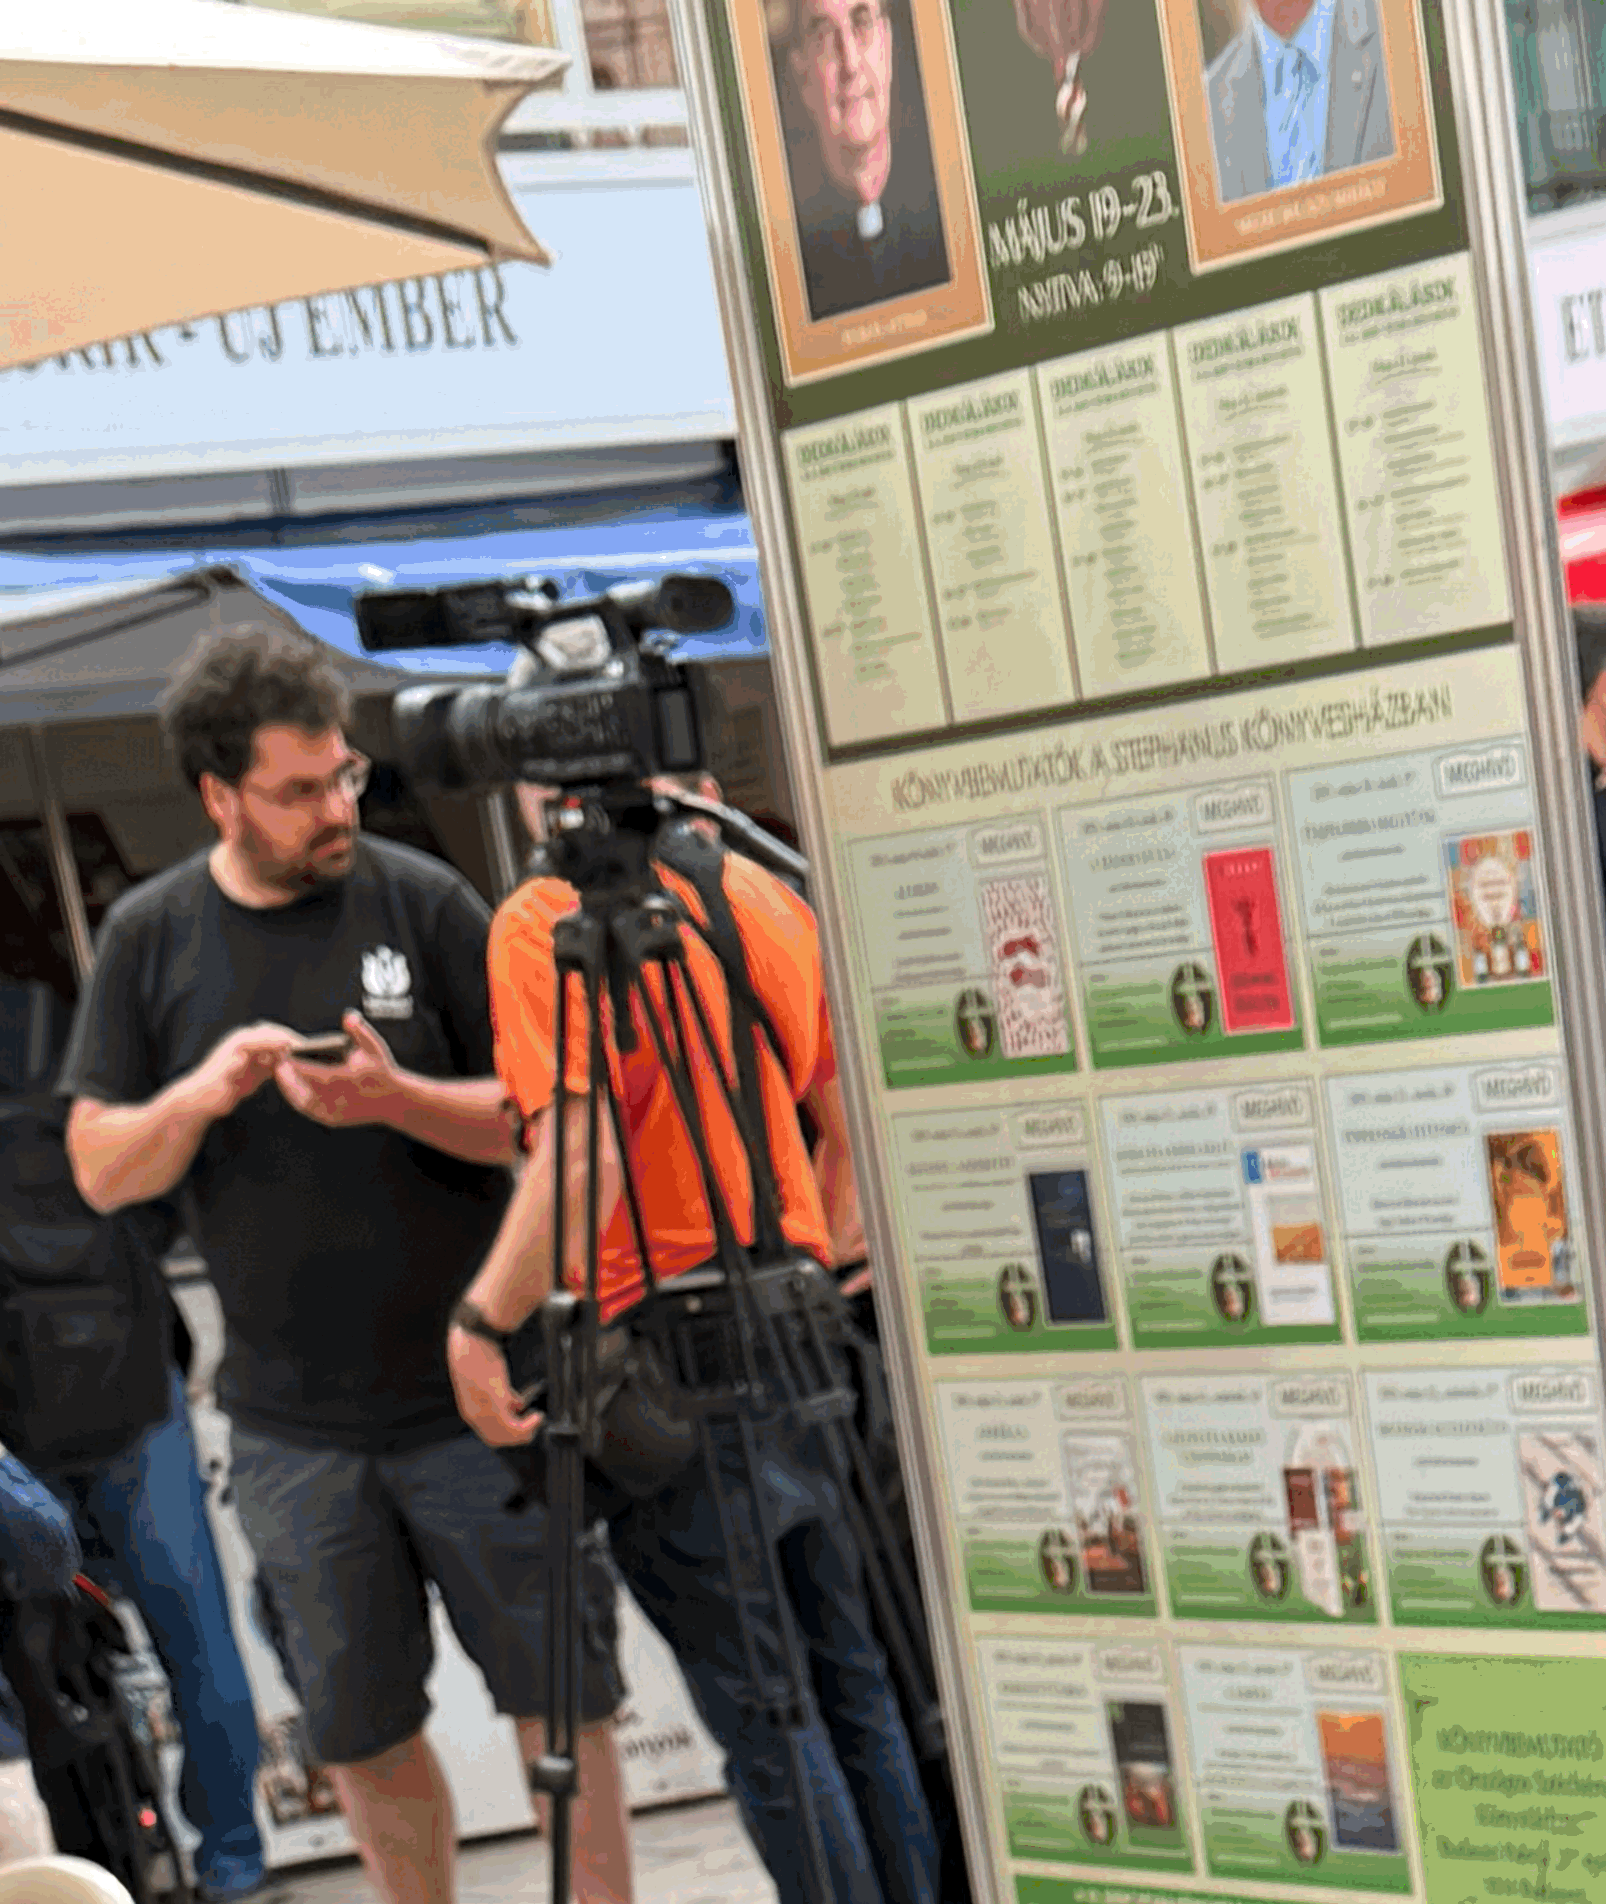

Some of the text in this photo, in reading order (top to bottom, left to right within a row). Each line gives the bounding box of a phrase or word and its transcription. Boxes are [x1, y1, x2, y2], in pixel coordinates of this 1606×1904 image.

[988, 197, 1086, 268] MÁJUS
[1088, 170, 1180, 240] 19-23.
[305, 264, 518, 358] EMBER
